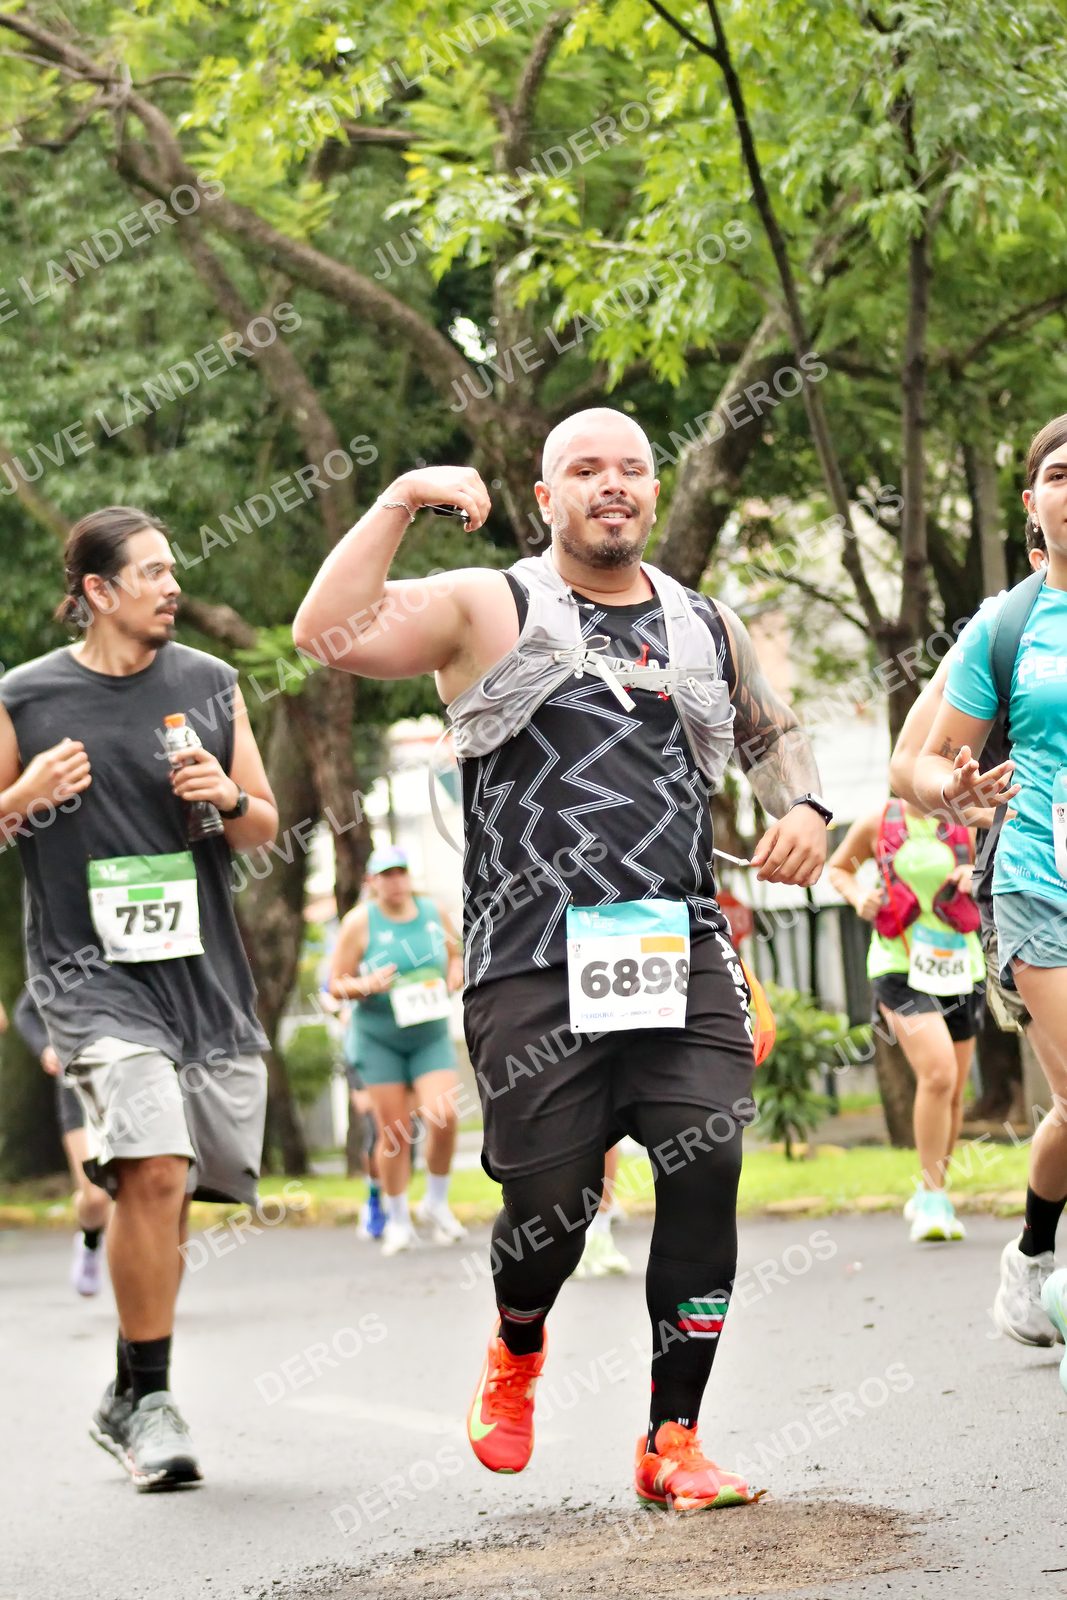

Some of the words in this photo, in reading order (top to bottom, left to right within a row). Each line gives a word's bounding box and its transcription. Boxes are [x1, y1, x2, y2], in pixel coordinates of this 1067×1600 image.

[116, 902, 183, 936] 757
[581, 957, 689, 1000] 6898
[914, 956, 965, 978] 4268
